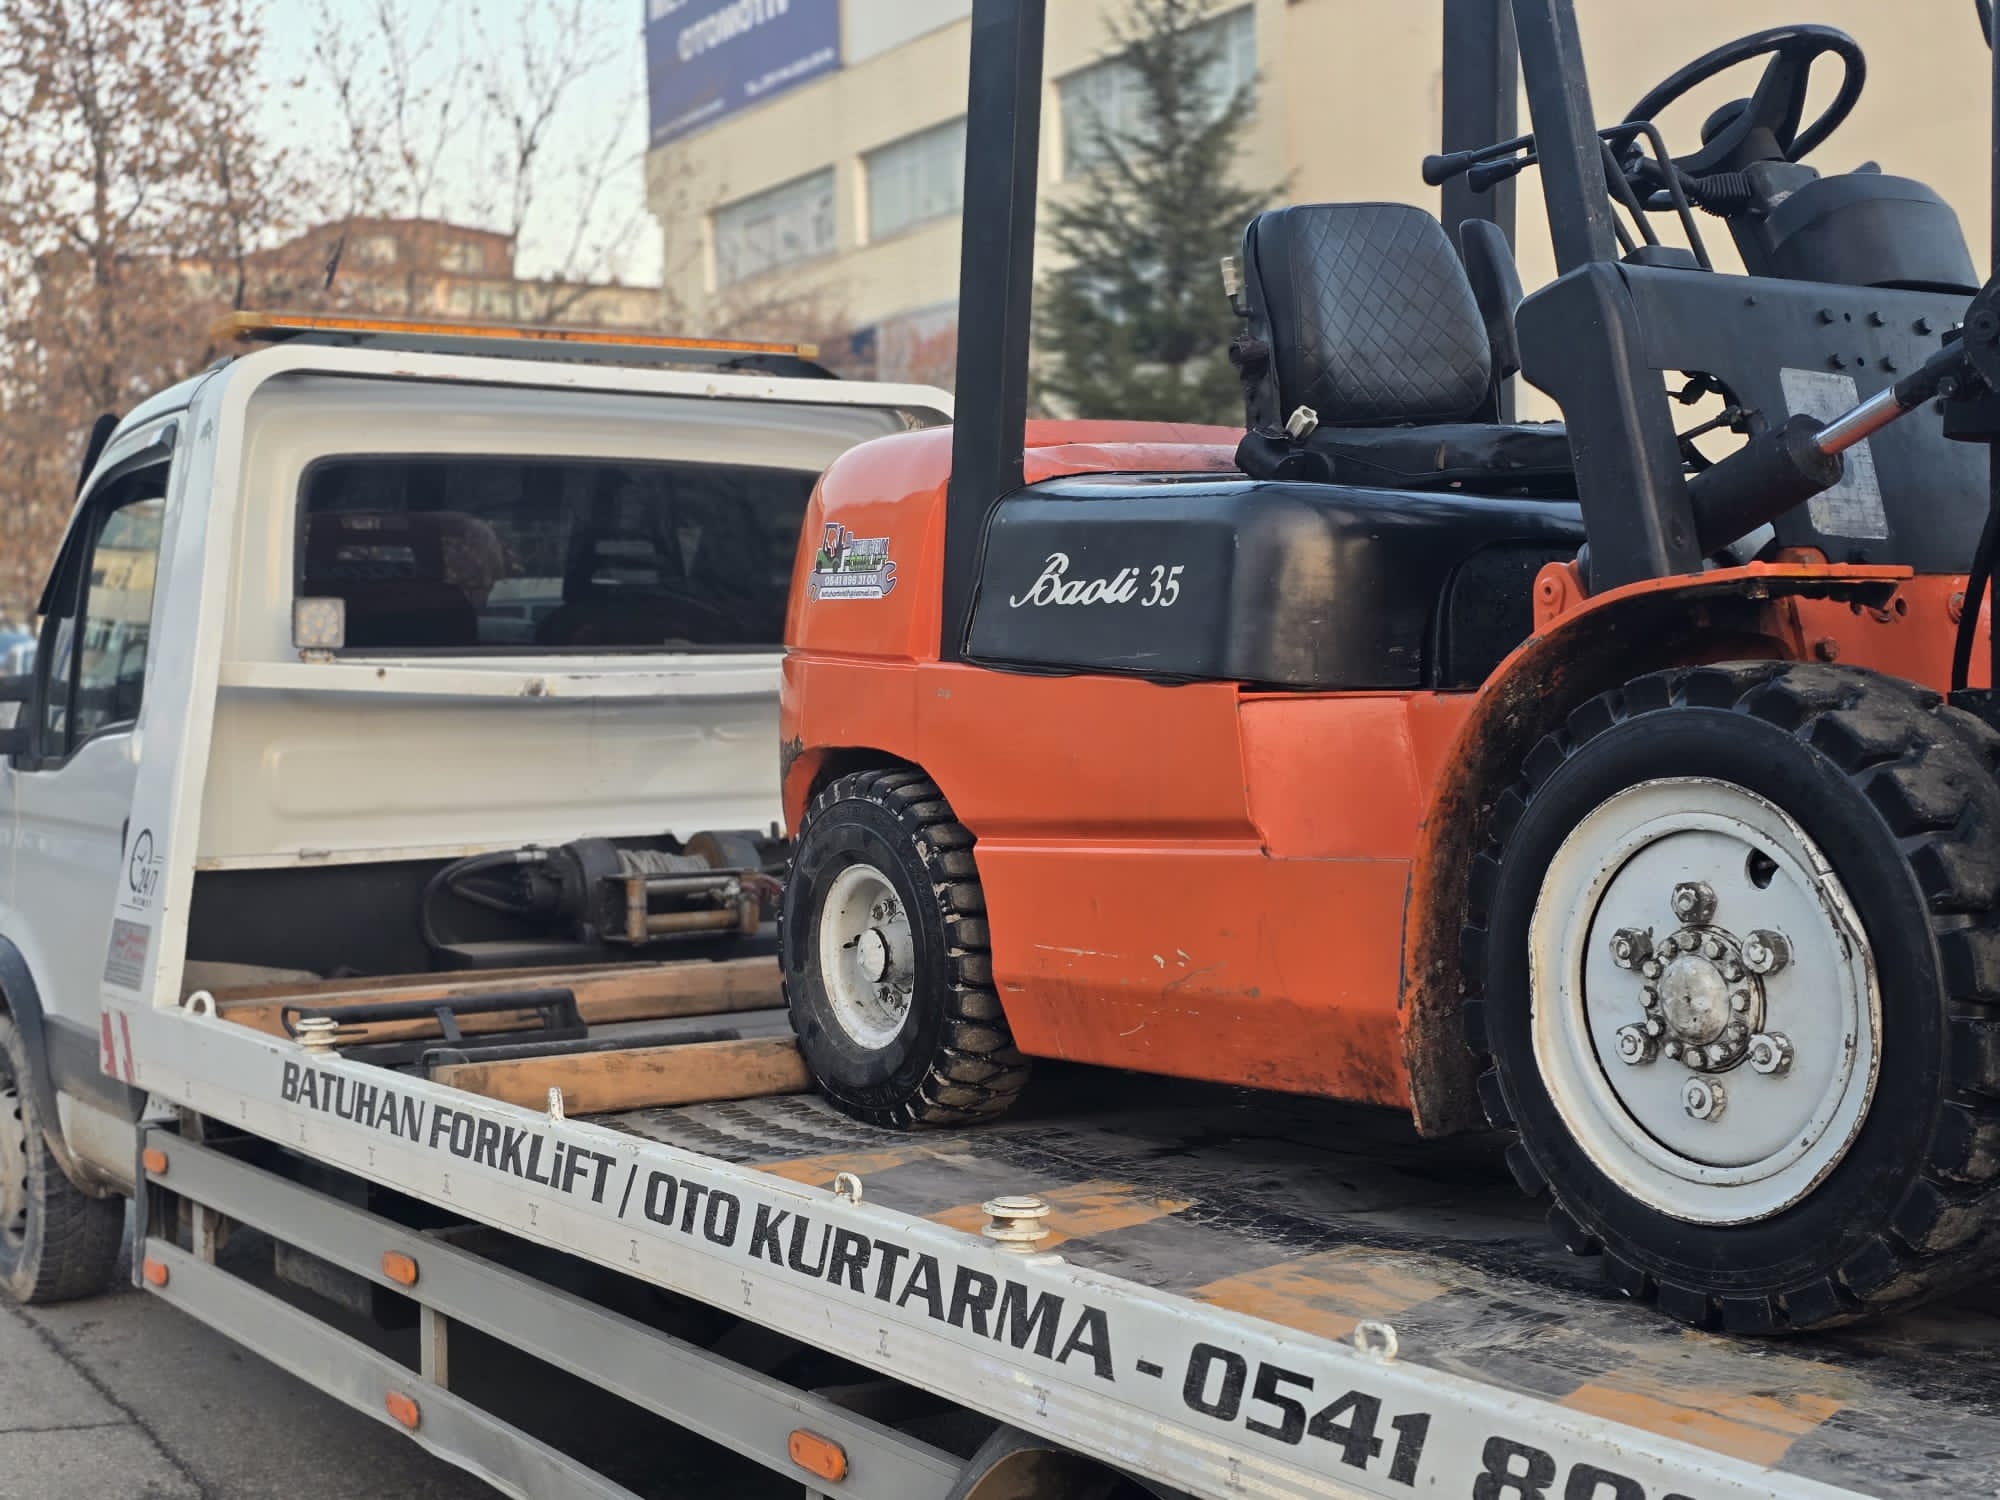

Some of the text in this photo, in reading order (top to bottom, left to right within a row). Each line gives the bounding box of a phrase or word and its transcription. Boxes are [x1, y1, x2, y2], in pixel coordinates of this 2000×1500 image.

[1009, 552, 1185, 608] Baoli 35
[280, 1060, 425, 1144] BATUHAN
[617, 1163, 638, 1219] /
[643, 1170, 739, 1249] OTO
[748, 1202, 1117, 1383] KURTARMA
[1182, 1341, 1432, 1489] 0541
